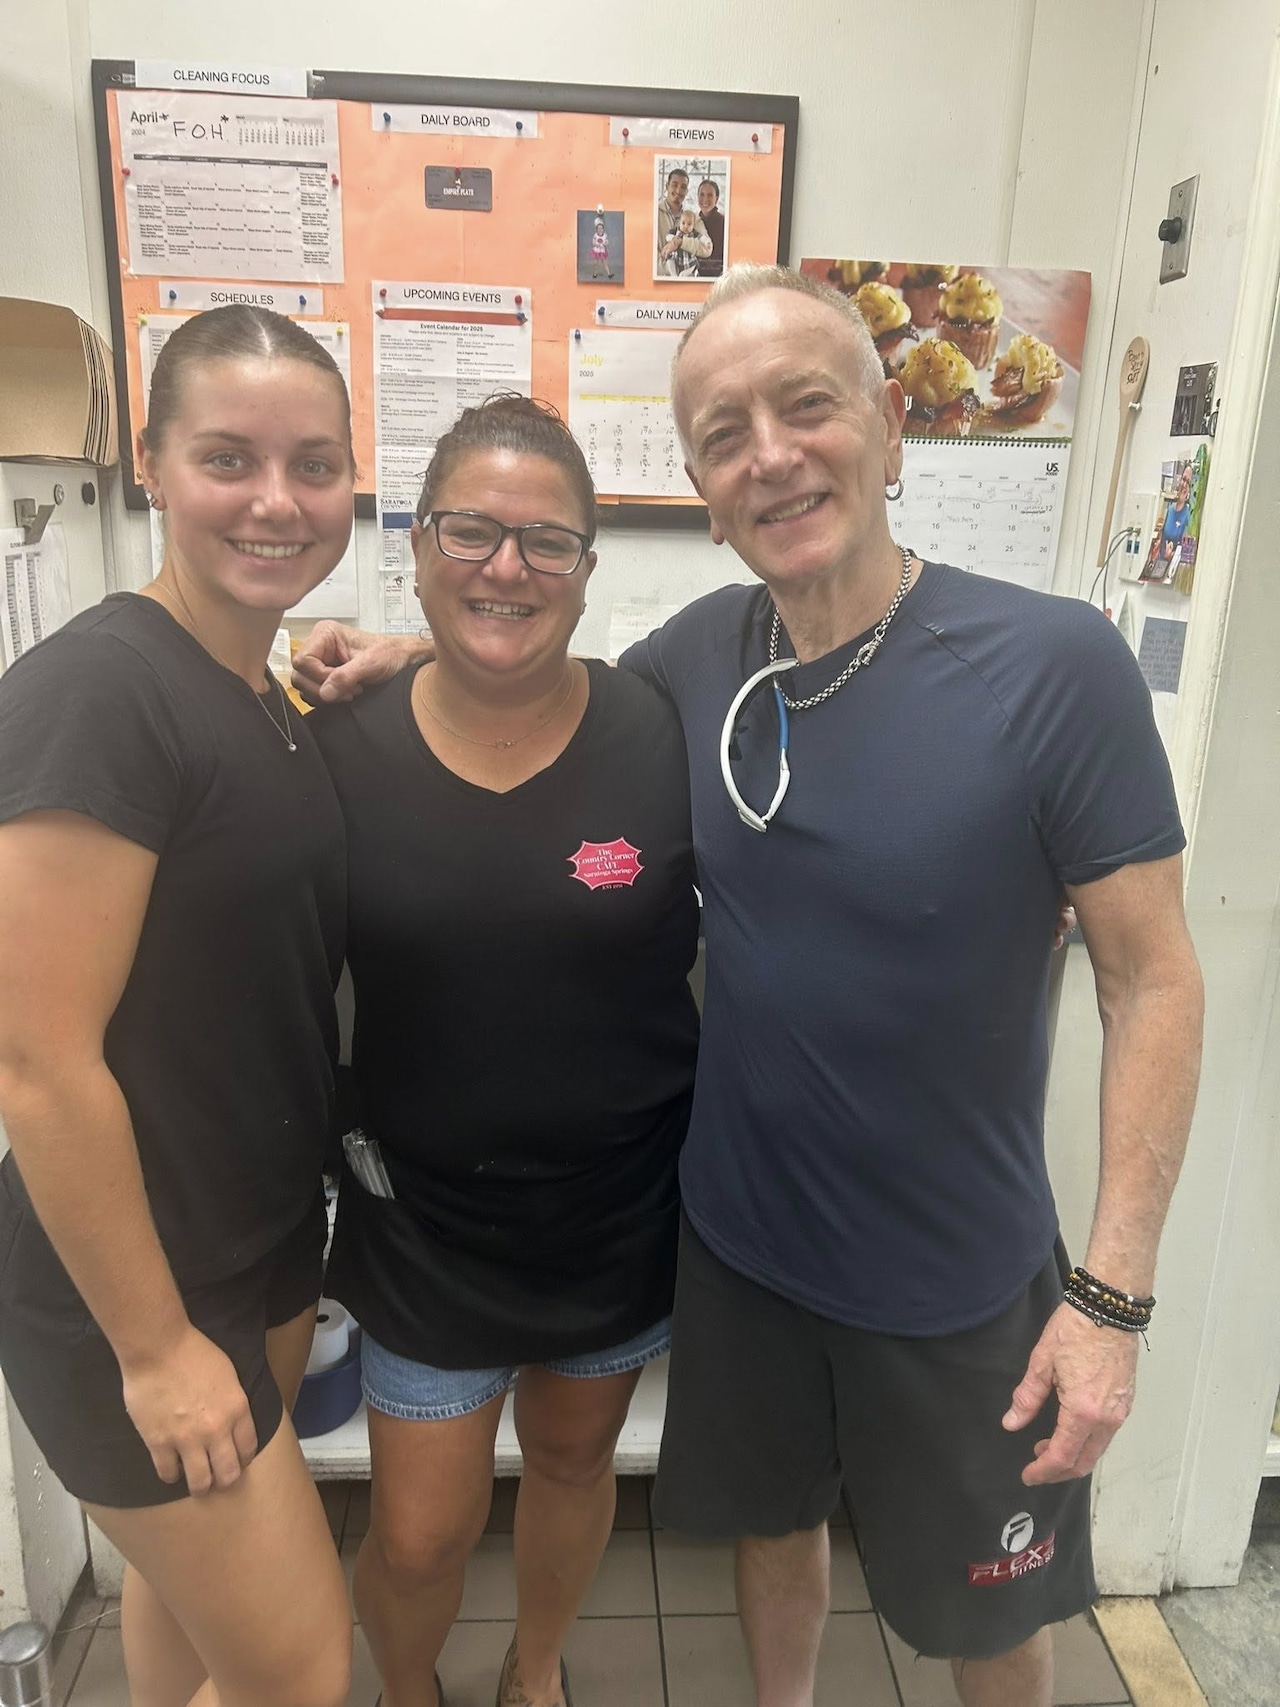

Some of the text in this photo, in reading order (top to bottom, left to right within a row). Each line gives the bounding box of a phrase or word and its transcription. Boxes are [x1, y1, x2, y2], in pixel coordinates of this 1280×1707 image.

[173, 69, 270, 85] CLEANING FOCUS
[130, 111, 158, 125] April
[421, 114, 491, 127] DAILY BOARD
[669, 128, 715, 141] REVIEWS
[210, 292, 274, 305] SCHEDULES
[403, 288, 502, 304] UPCOMING EVENTS
[636, 309, 664, 319] DAILY
[580, 354, 604, 367] July
[939, 480, 944, 488] 2
[977, 481, 983, 489] 3
[937, 501, 943, 509] 9
[972, 502, 981, 510] 10
[894, 521, 903, 529] 15
[932, 522, 941, 530] 16
[929, 543, 939, 551] 23
[1004, 545, 1014, 553] 25
[577, 852, 635, 864] Country Corner
[598, 848, 612, 856] The
[583, 868, 634, 878] Saratoga Springs
